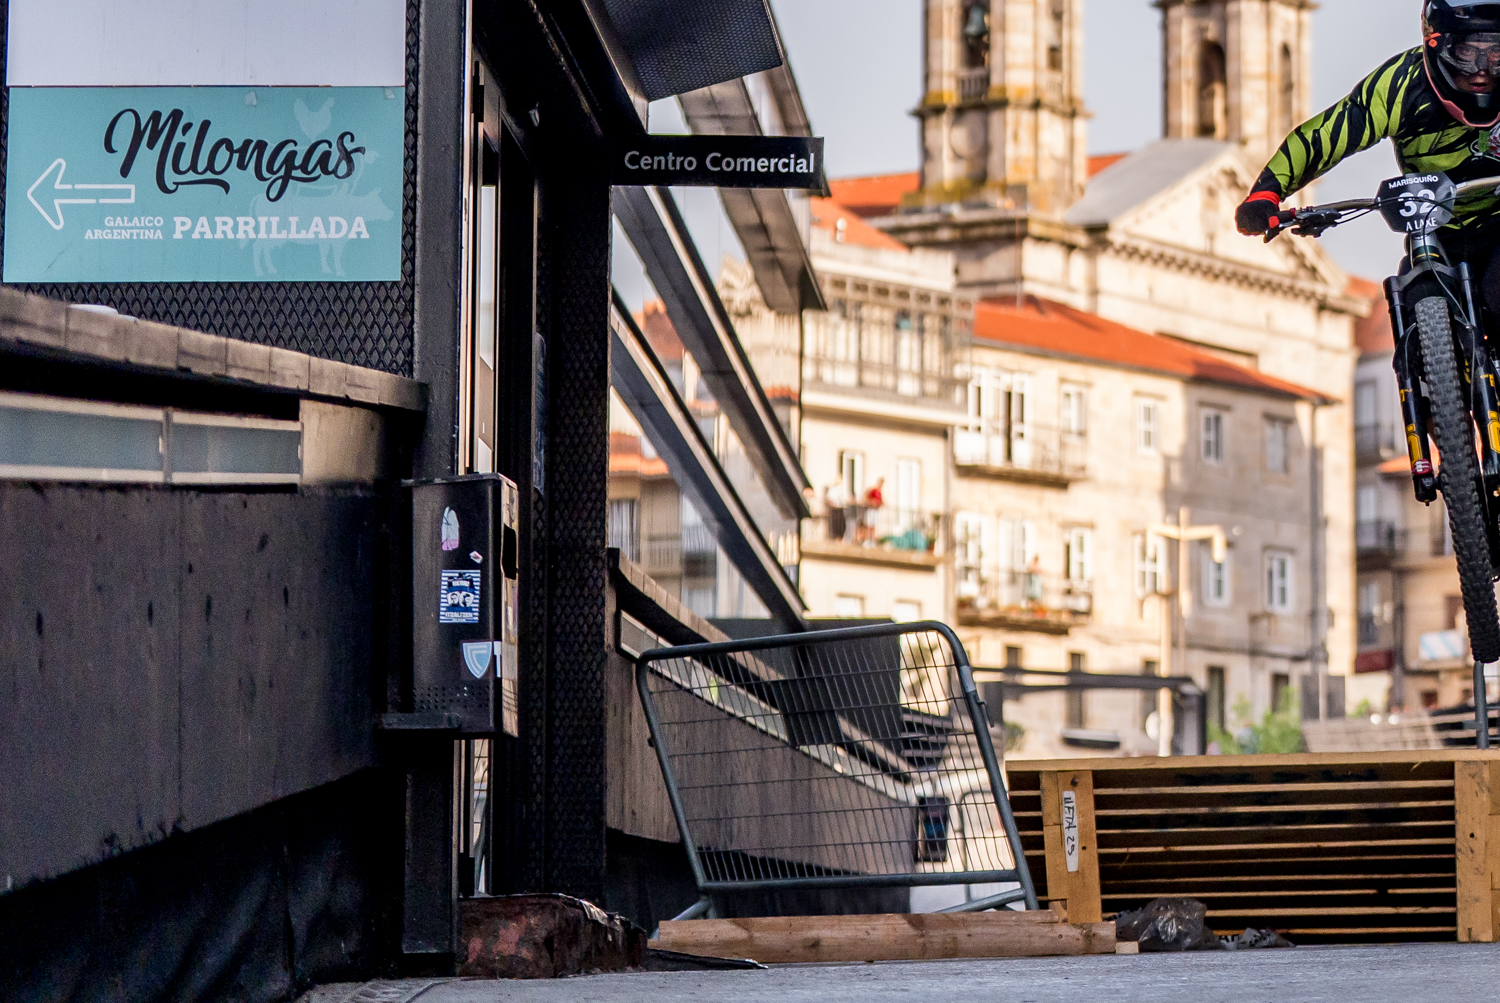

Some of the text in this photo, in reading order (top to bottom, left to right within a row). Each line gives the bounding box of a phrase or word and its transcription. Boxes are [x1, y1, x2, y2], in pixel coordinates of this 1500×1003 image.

[104, 108, 366, 202] Milongas
[623, 150, 815, 174] Centro Comercial
[1388, 175, 1439, 189] MARISQUIÑO
[1397, 189, 1438, 217] 32
[104, 215, 164, 227] GALAICO
[172, 215, 370, 239] PARRILLADA
[1406, 222, 1413, 231] A
[84, 228, 164, 240] ARGENTINA
